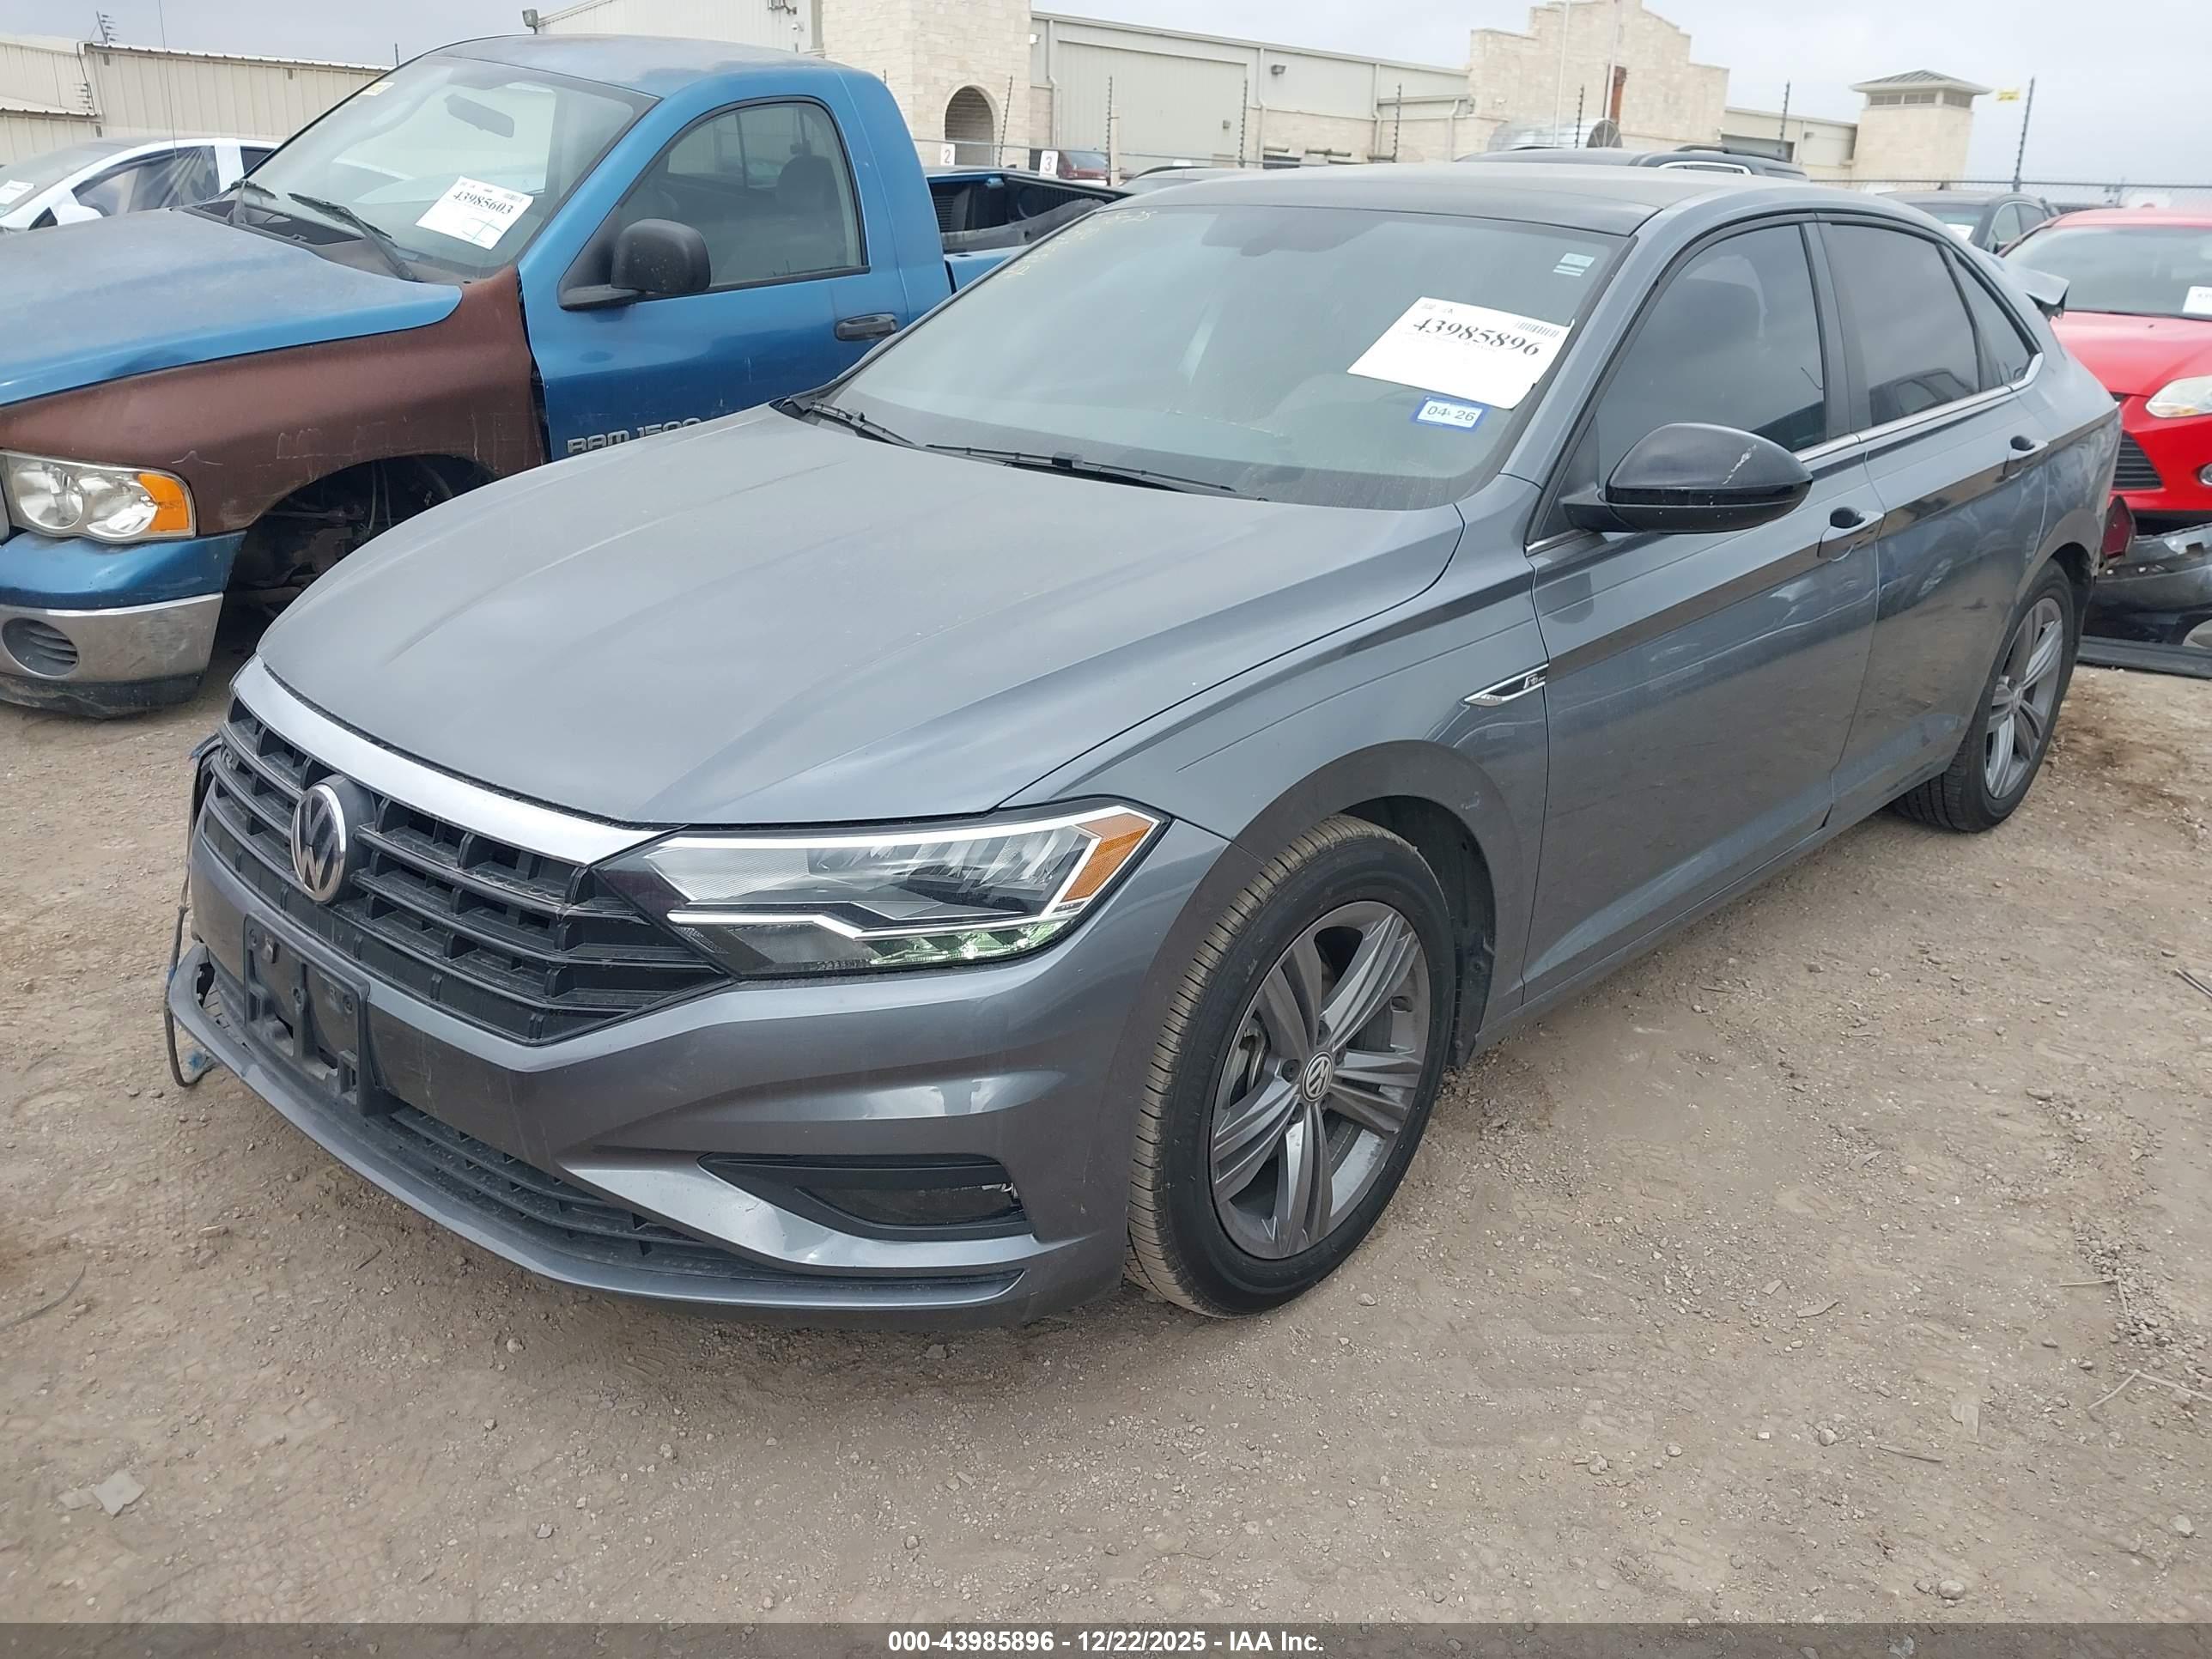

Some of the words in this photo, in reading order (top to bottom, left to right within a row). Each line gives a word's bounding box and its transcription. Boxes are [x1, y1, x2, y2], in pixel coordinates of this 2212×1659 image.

[944, 149, 951, 164] 2
[1044, 156, 1053, 172] 3
[453, 191, 514, 214] 43985603
[1413, 318, 1541, 356] 43985896
[567, 429, 629, 453] RAM
